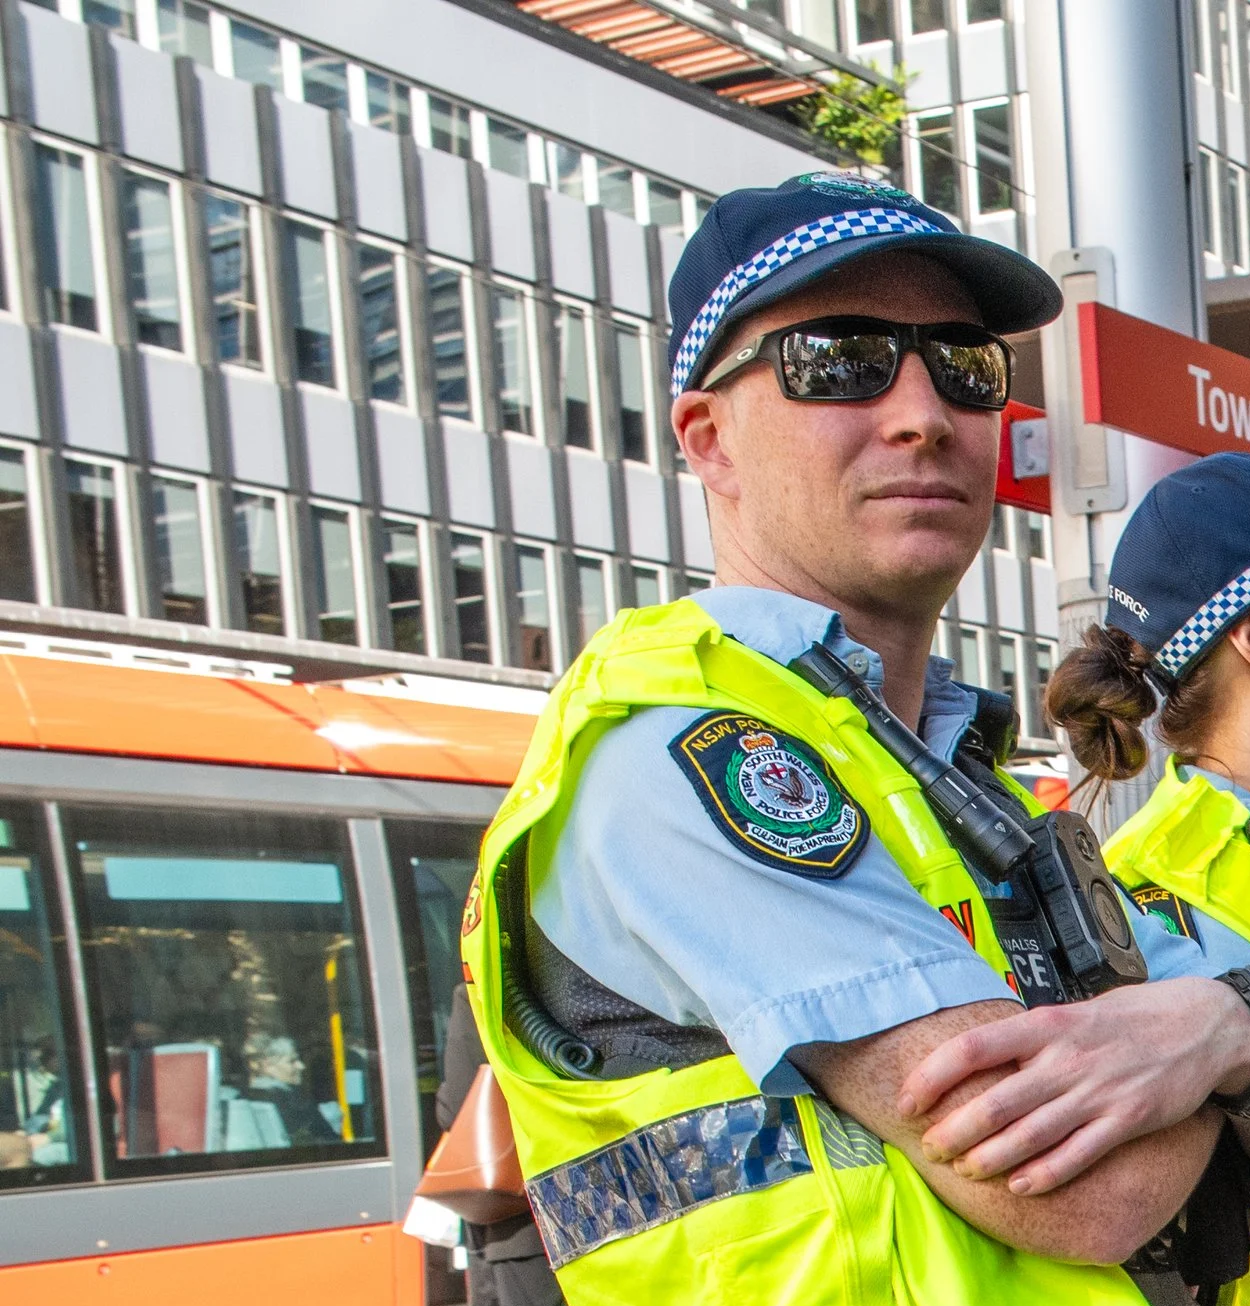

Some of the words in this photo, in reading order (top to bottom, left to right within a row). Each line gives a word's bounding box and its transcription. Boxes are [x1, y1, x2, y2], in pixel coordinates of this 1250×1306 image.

[1114, 588, 1150, 622] FORCE
[691, 721, 736, 752] N.S.W.
[745, 752, 783, 770] SOUTH
[785, 753, 822, 786] WALES
[741, 771, 757, 797] NEW
[756, 800, 805, 820] POLICE
[805, 790, 827, 818] FORCE
[1135, 890, 1169, 905] OLICE
